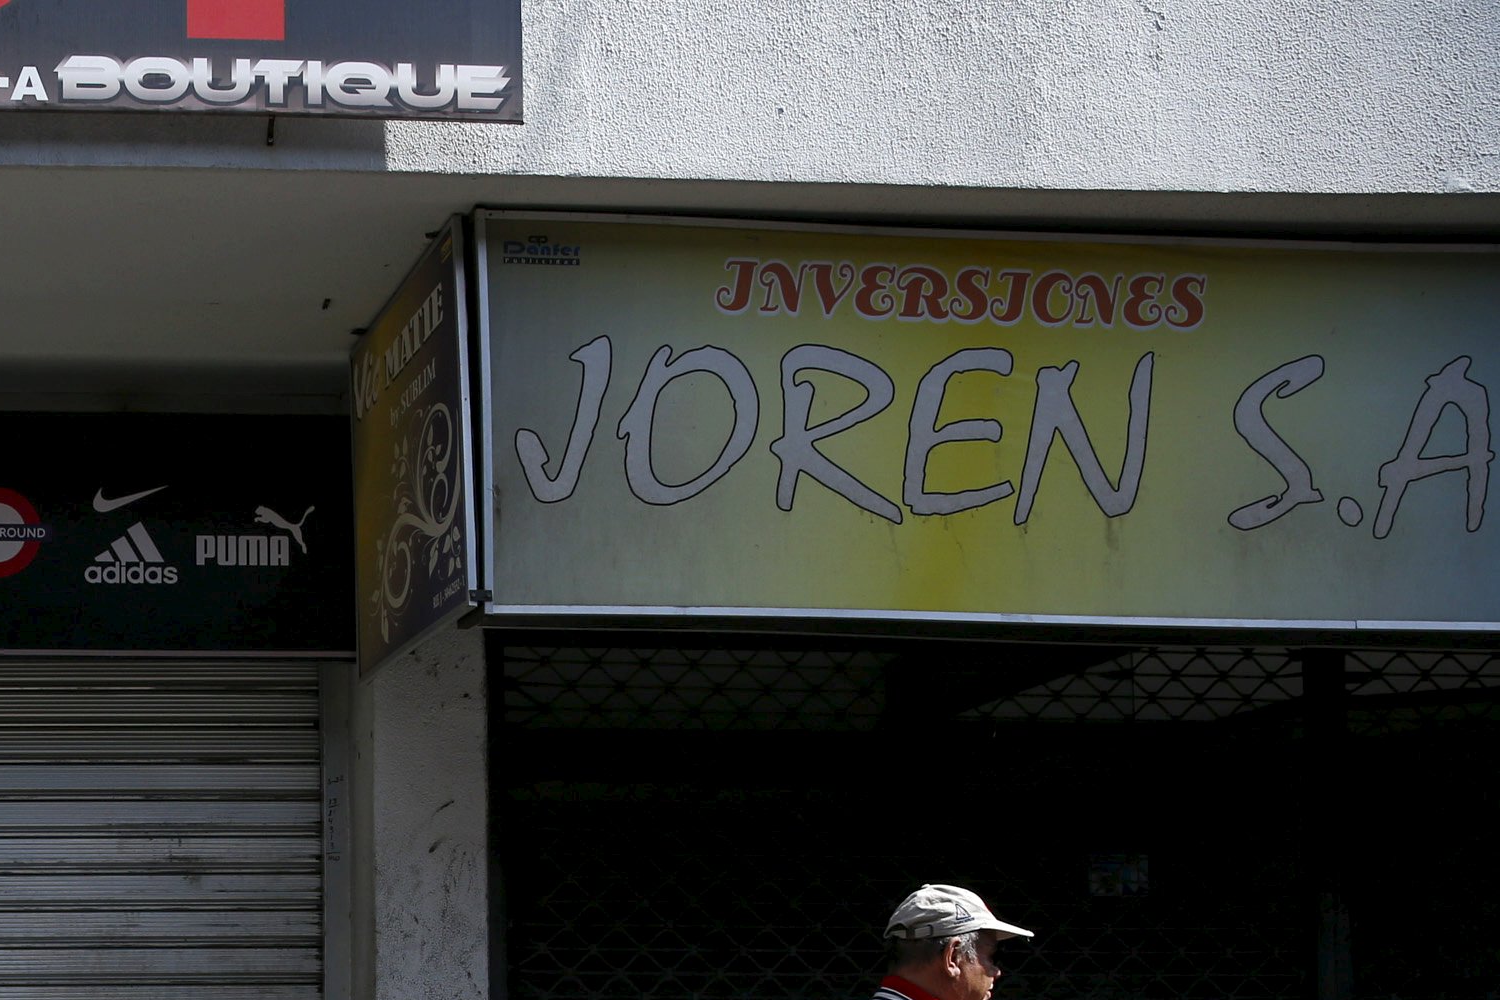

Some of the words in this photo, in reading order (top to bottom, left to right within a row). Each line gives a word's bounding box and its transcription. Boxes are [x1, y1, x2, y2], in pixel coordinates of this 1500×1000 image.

[53, 54, 512, 111] BOUTIQUE
[514, 335, 1154, 526] JOREN
[1227, 354, 1496, 539] S.A
[83, 560, 180, 585] adidas
[195, 534, 290, 567] PUMA
